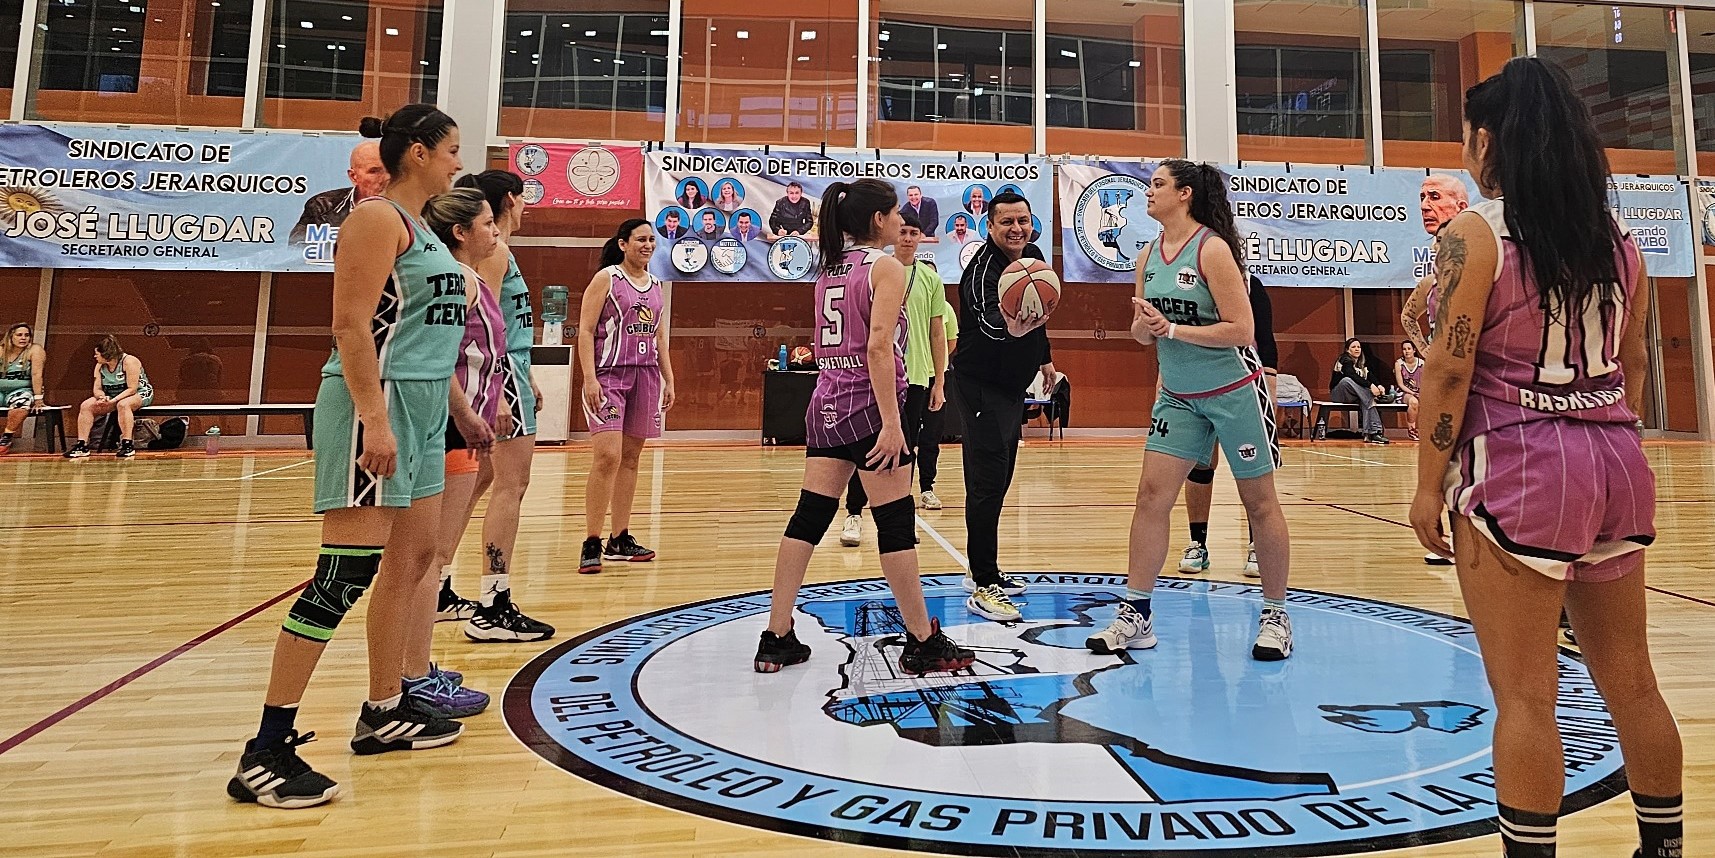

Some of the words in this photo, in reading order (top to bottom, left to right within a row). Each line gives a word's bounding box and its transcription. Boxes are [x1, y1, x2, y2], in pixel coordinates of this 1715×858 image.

[68, 139, 194, 162] SINDICATO
[200, 144, 231, 163] DE
[661, 155, 762, 174] SINDICATO
[767, 159, 790, 175] DE
[797, 160, 911, 179] PETROLEROS
[917, 164, 1039, 180] JERARQUICOS
[142, 171, 307, 194] JERARQUICOS
[1230, 176, 1321, 194] SINDICATO
[1326, 179, 1347, 194] DE
[6, 206, 98, 240] JOSÉ
[107, 213, 275, 243] LLUGDAR
[1287, 204, 1407, 222] JERARQUICOS
[1623, 206, 1684, 221] LLUGDAR
[61, 243, 149, 257] SECRETARIO
[153, 244, 219, 258] GENERAL
[1267, 238, 1389, 263] LLUGDAR
[1302, 265, 1350, 276] GENERAL
[820, 285, 845, 348] 5
[638, 341, 647, 355] 8
[570, 609, 710, 666] SINDICATO
[706, 599, 764, 615] DEL
[549, 692, 619, 732] DEL
[578, 718, 783, 799] PETRÓLEO
[776, 784, 838, 809] Y
[1389, 783, 1487, 822] LA
[830, 794, 970, 832] GAS
[991, 808, 1297, 842] PRIVADO
[1301, 797, 1399, 831] DE
